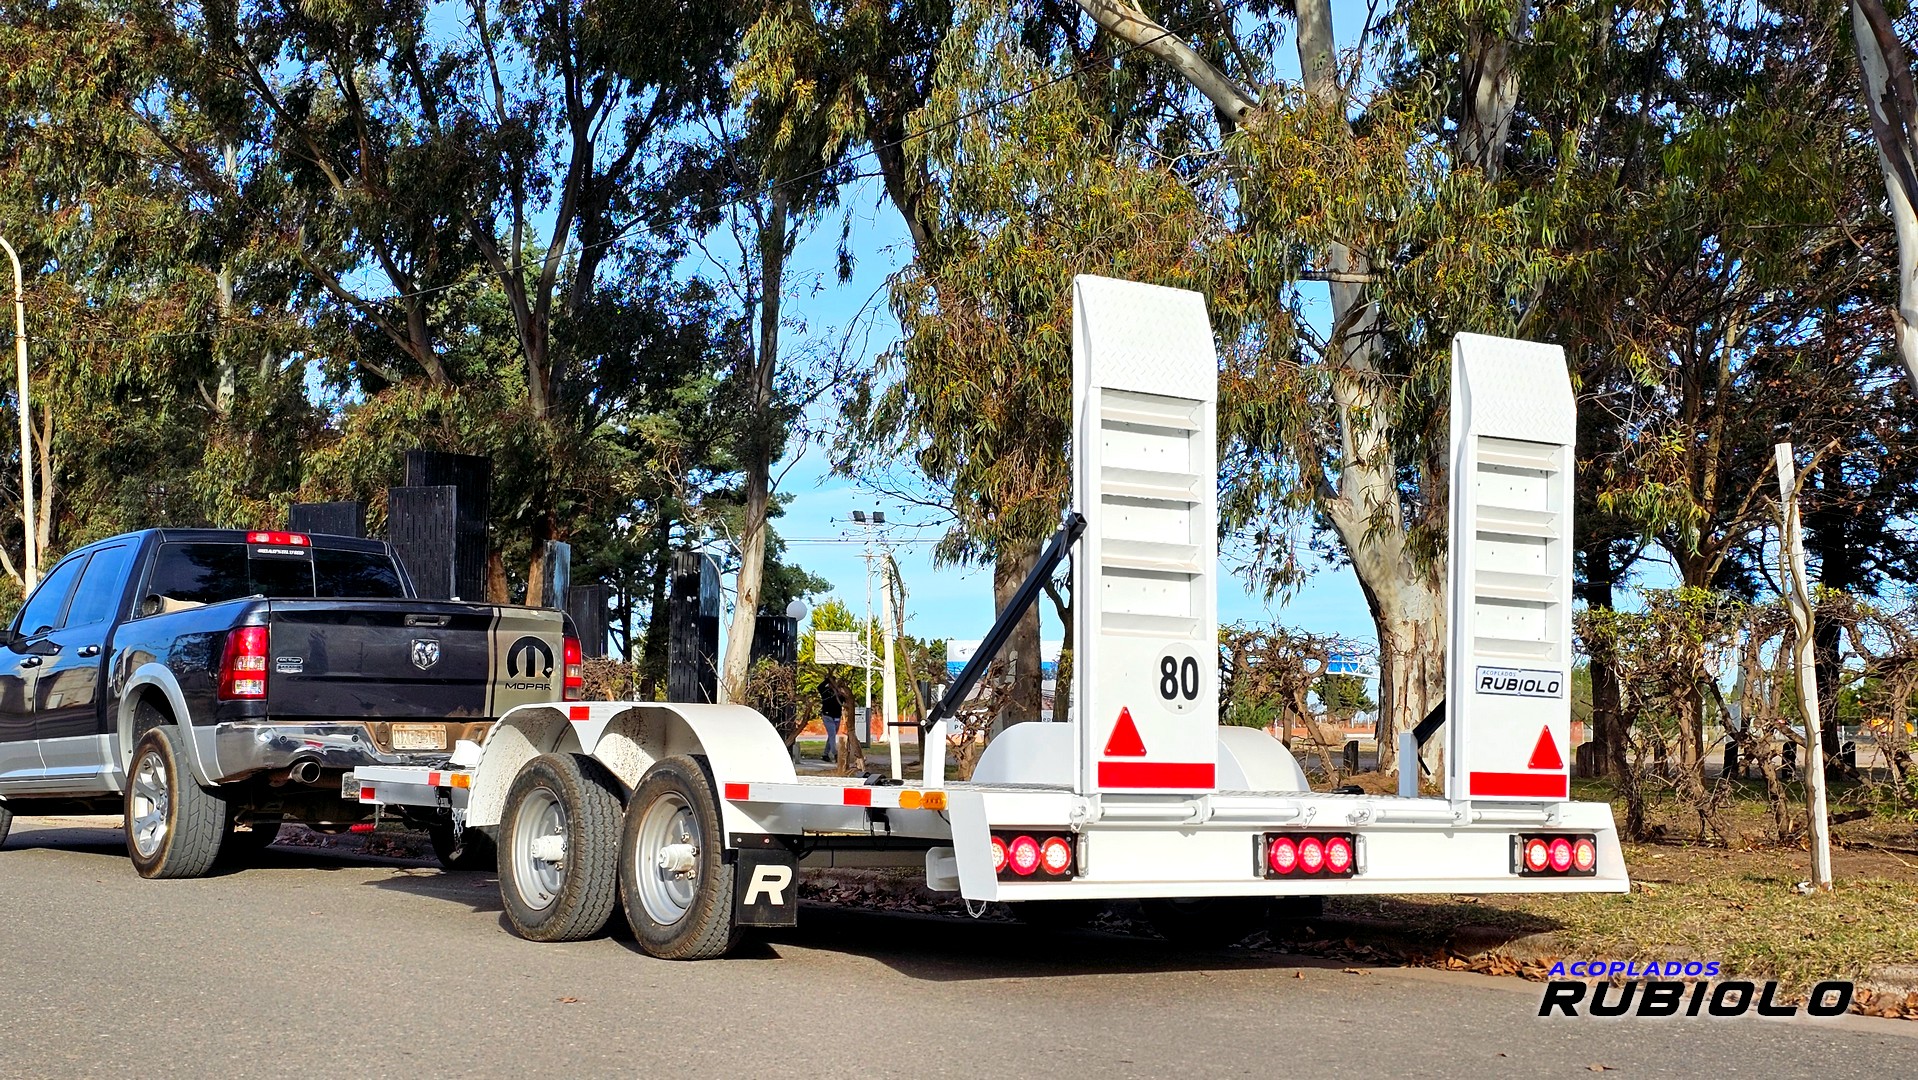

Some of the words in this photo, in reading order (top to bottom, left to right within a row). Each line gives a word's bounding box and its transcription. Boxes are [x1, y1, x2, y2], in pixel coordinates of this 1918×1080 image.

[1160, 655, 1199, 701] 80
[1482, 670, 1517, 678] ACOPLADOS
[505, 682, 552, 691] MOPAR
[1480, 677, 1560, 694] RUBIOLO
[743, 864, 793, 906] R
